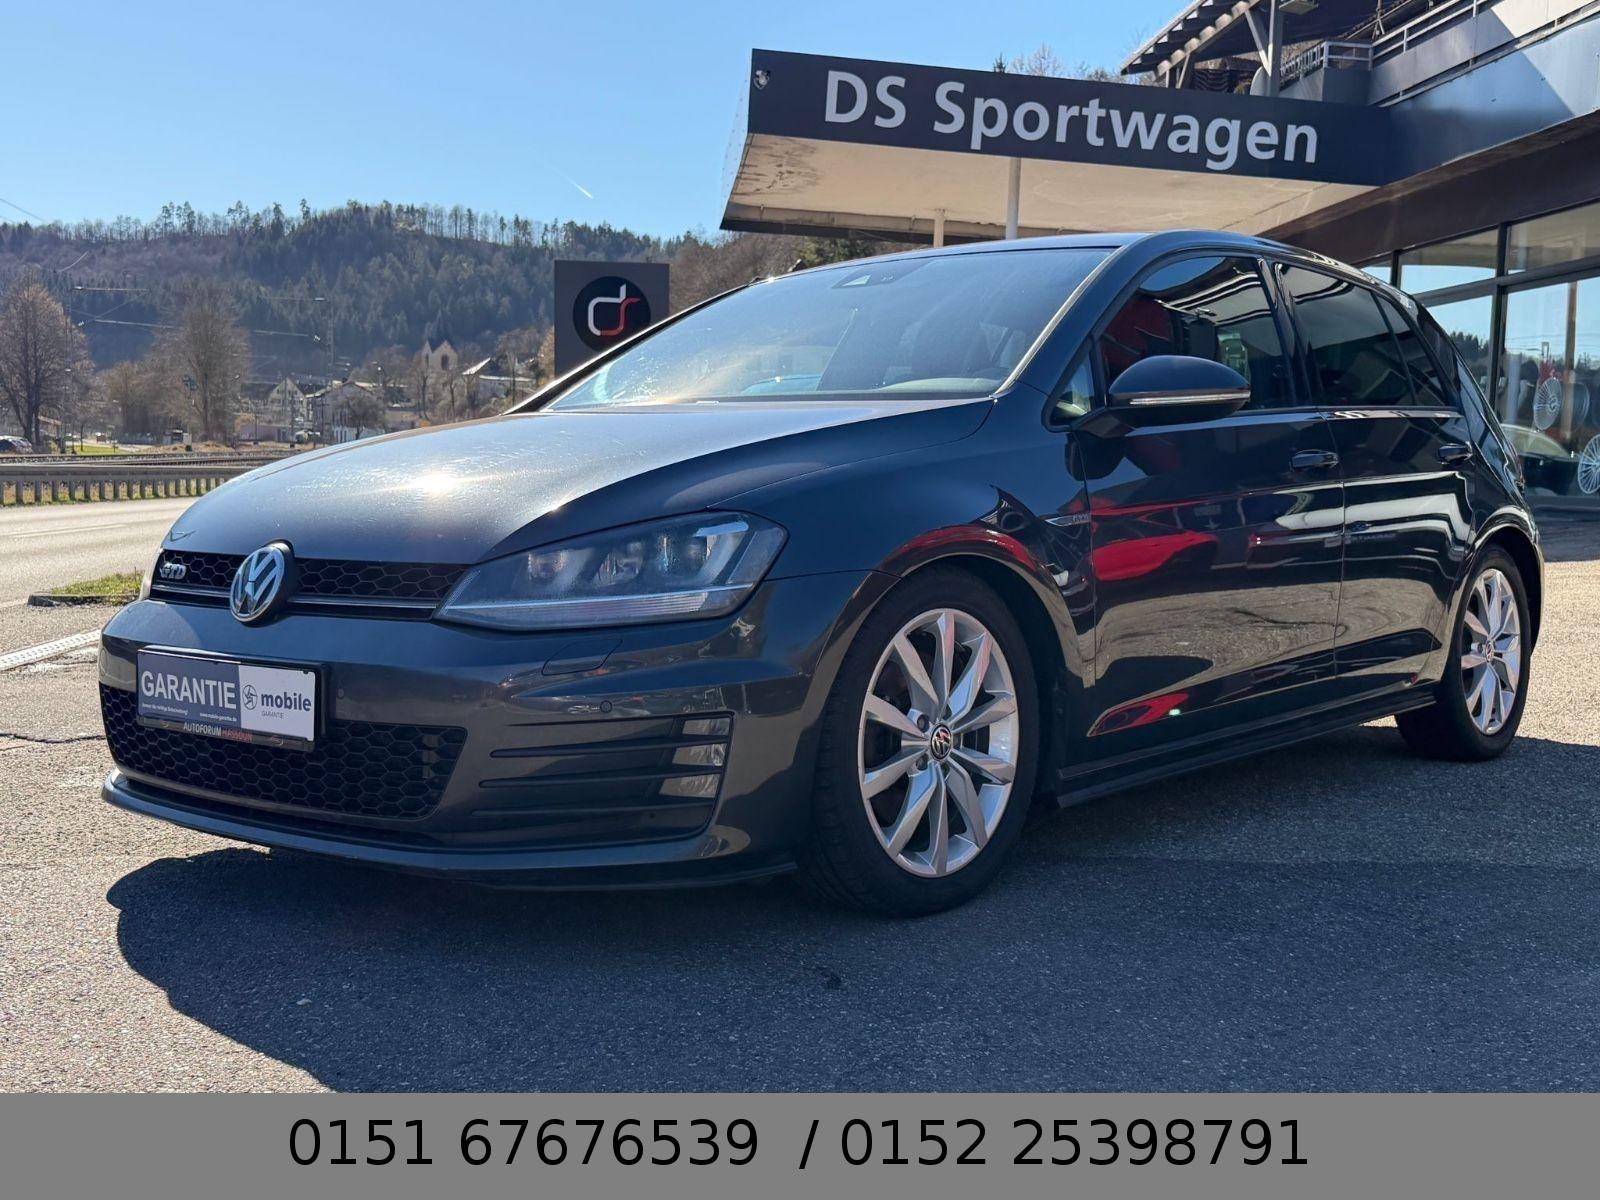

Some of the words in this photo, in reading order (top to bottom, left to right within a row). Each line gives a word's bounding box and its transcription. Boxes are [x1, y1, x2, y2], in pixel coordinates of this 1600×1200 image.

[824, 70, 906, 128] DS
[933, 81, 1318, 171] Sportwagen
[140, 670, 237, 710] GARANTIE
[261, 691, 312, 712] mobile
[183, 721, 222, 737] AUTOFORUM
